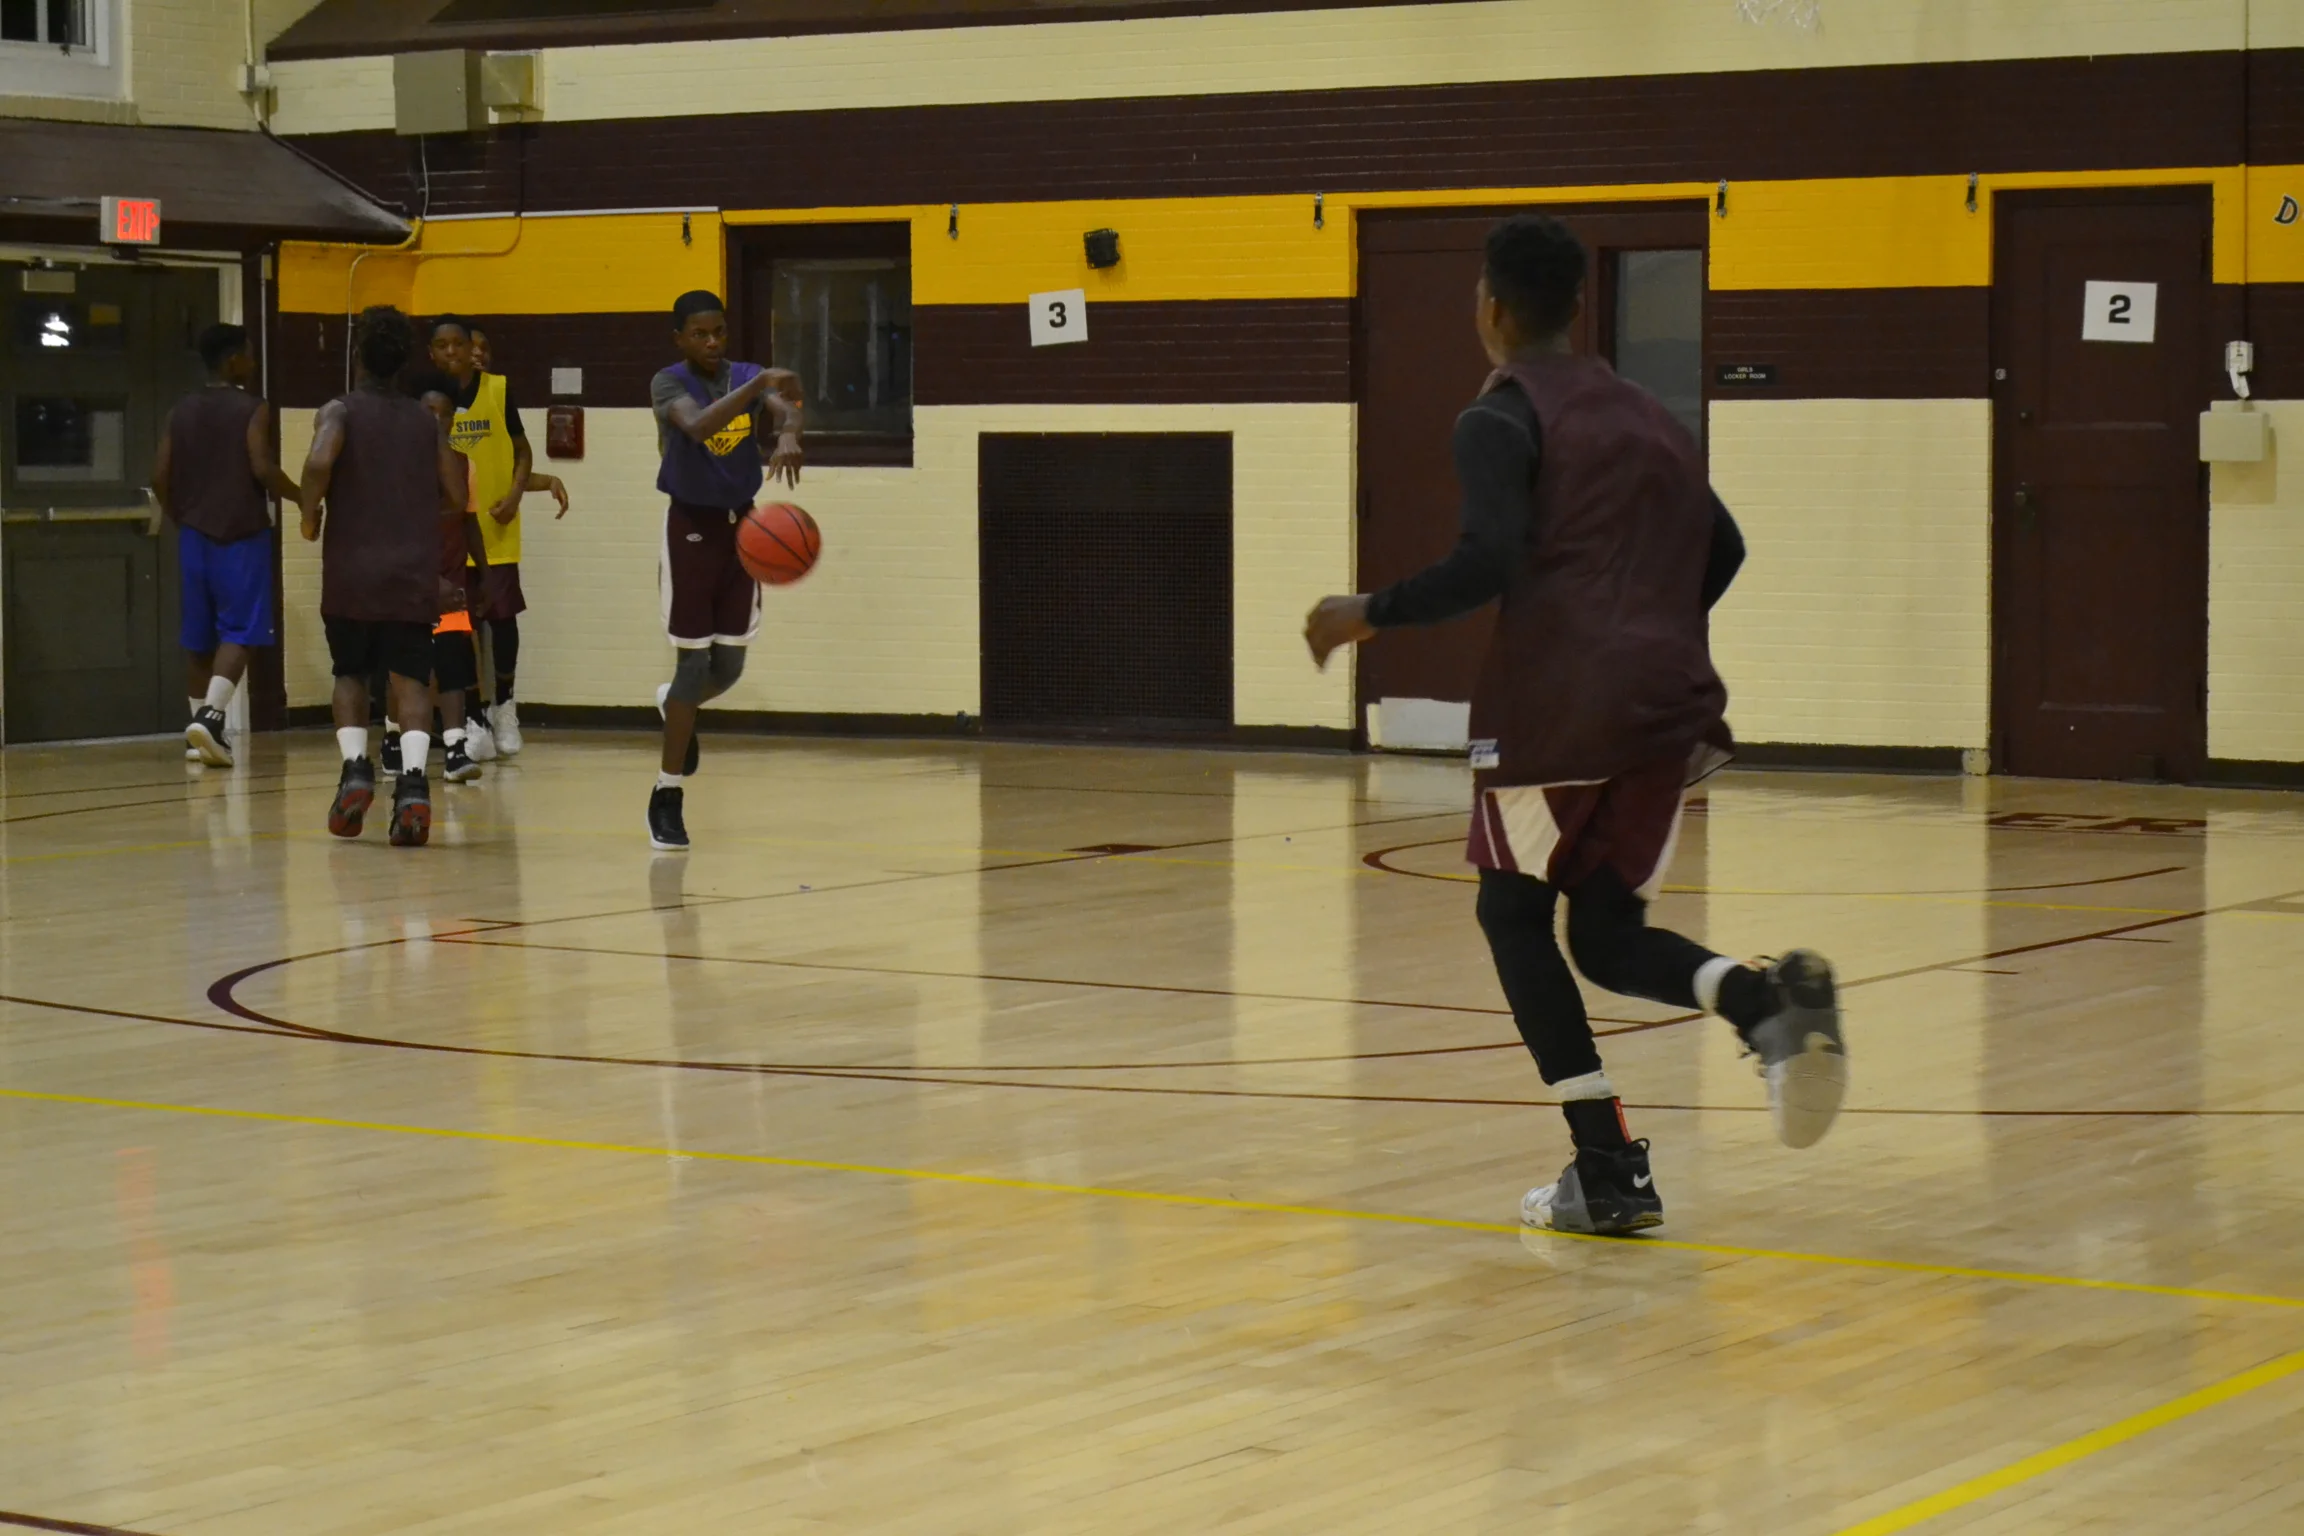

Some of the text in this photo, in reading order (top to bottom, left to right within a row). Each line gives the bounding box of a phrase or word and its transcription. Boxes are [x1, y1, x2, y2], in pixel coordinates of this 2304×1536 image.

[117, 200, 155, 241] EXIT
[1048, 301, 1067, 329] 3
[2108, 294, 2131, 324] 2
[455, 419, 491, 432] STORM
